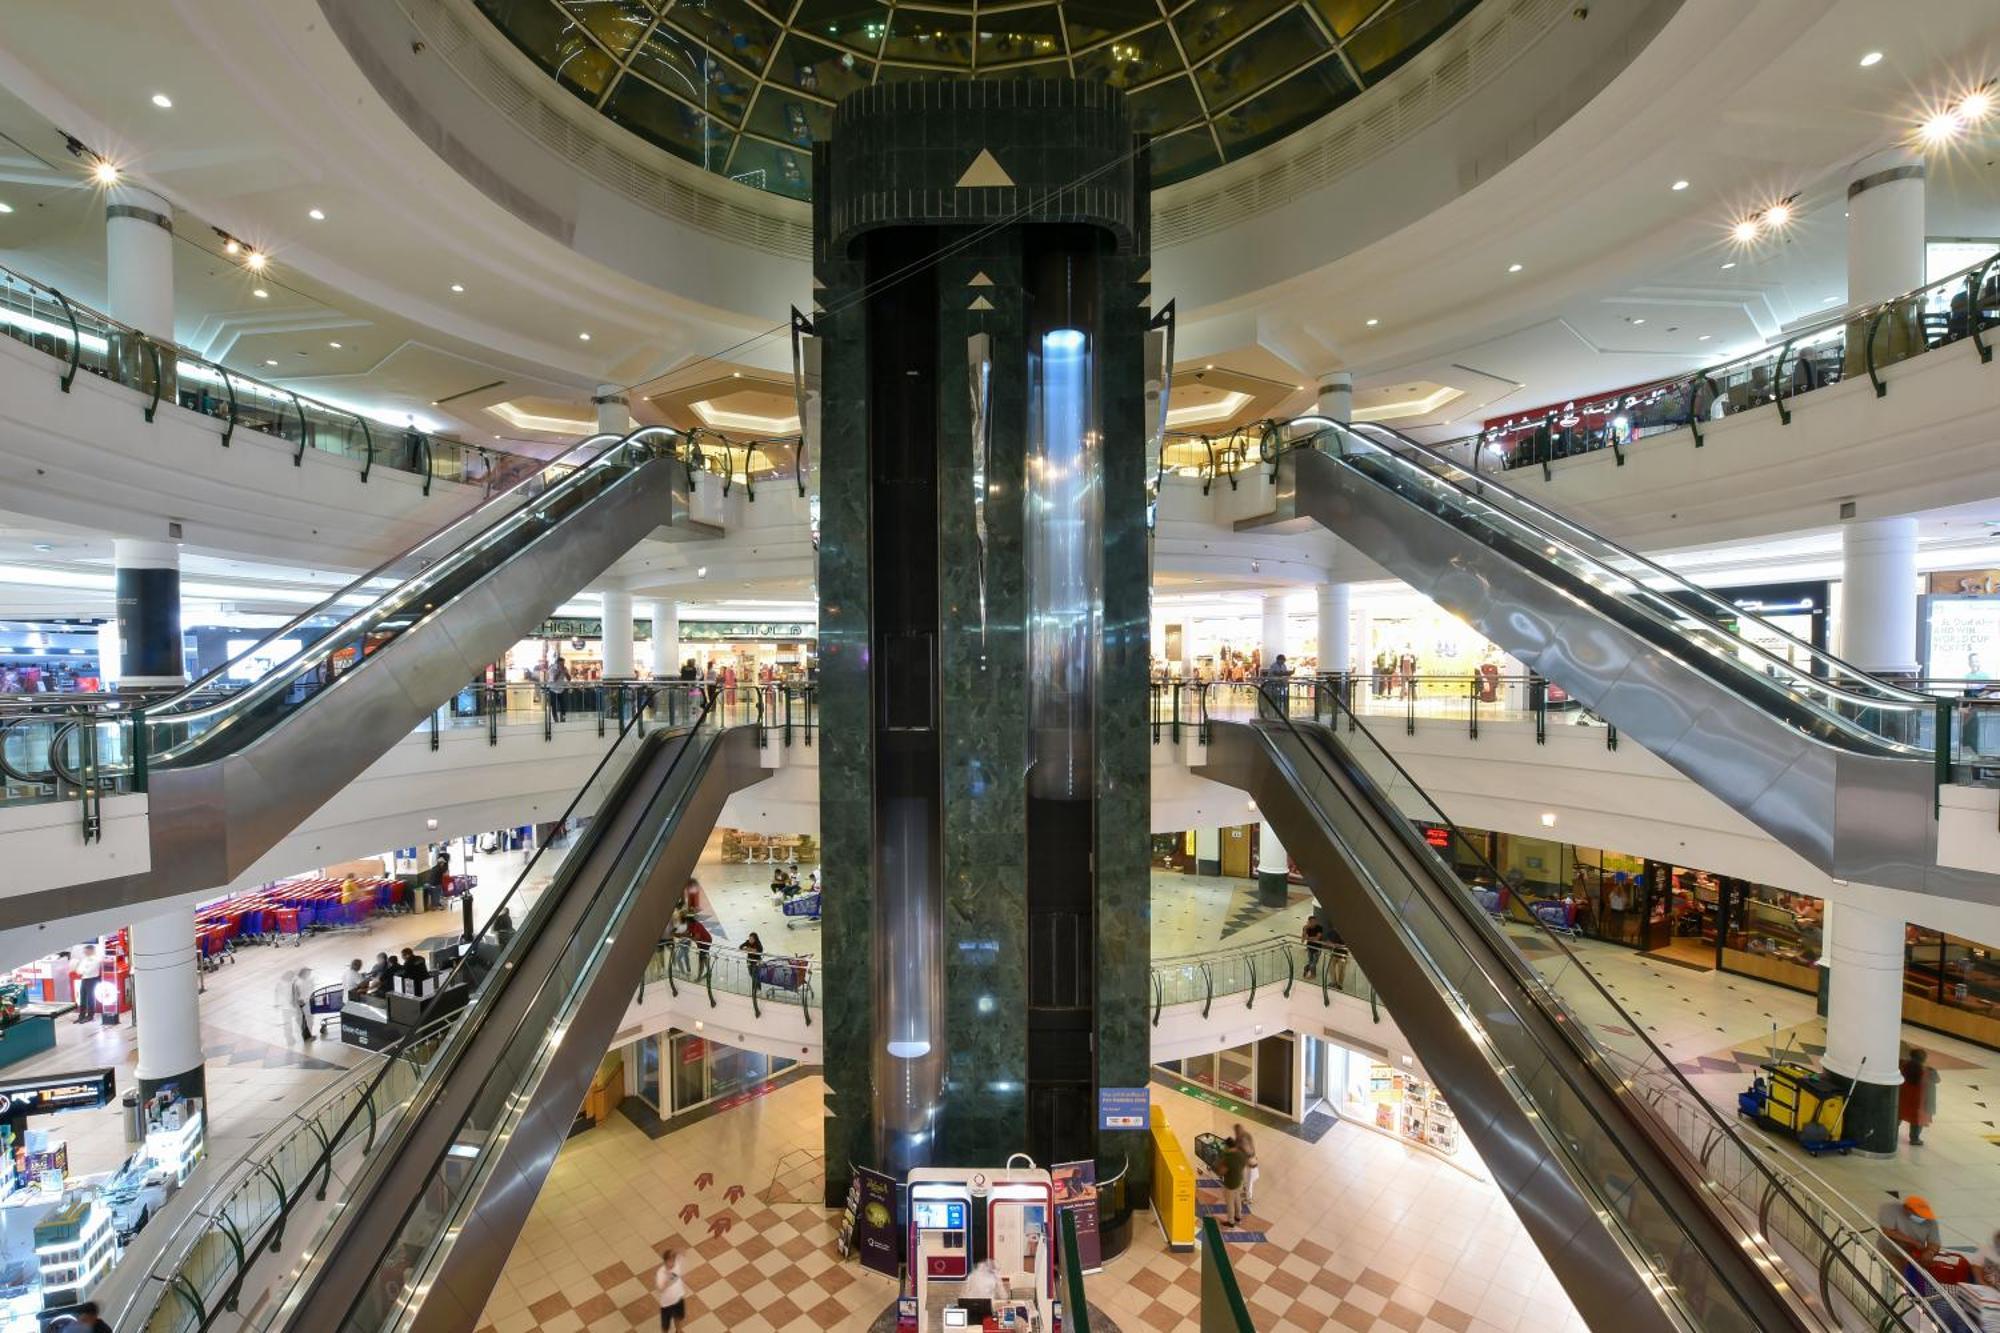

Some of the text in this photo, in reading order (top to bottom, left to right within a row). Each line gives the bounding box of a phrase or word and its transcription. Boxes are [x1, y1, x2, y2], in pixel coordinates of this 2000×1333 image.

[541, 622, 602, 634] HIGHLA
[1956, 626, 1976, 634] WIN
[1970, 634, 1990, 643] CUP
